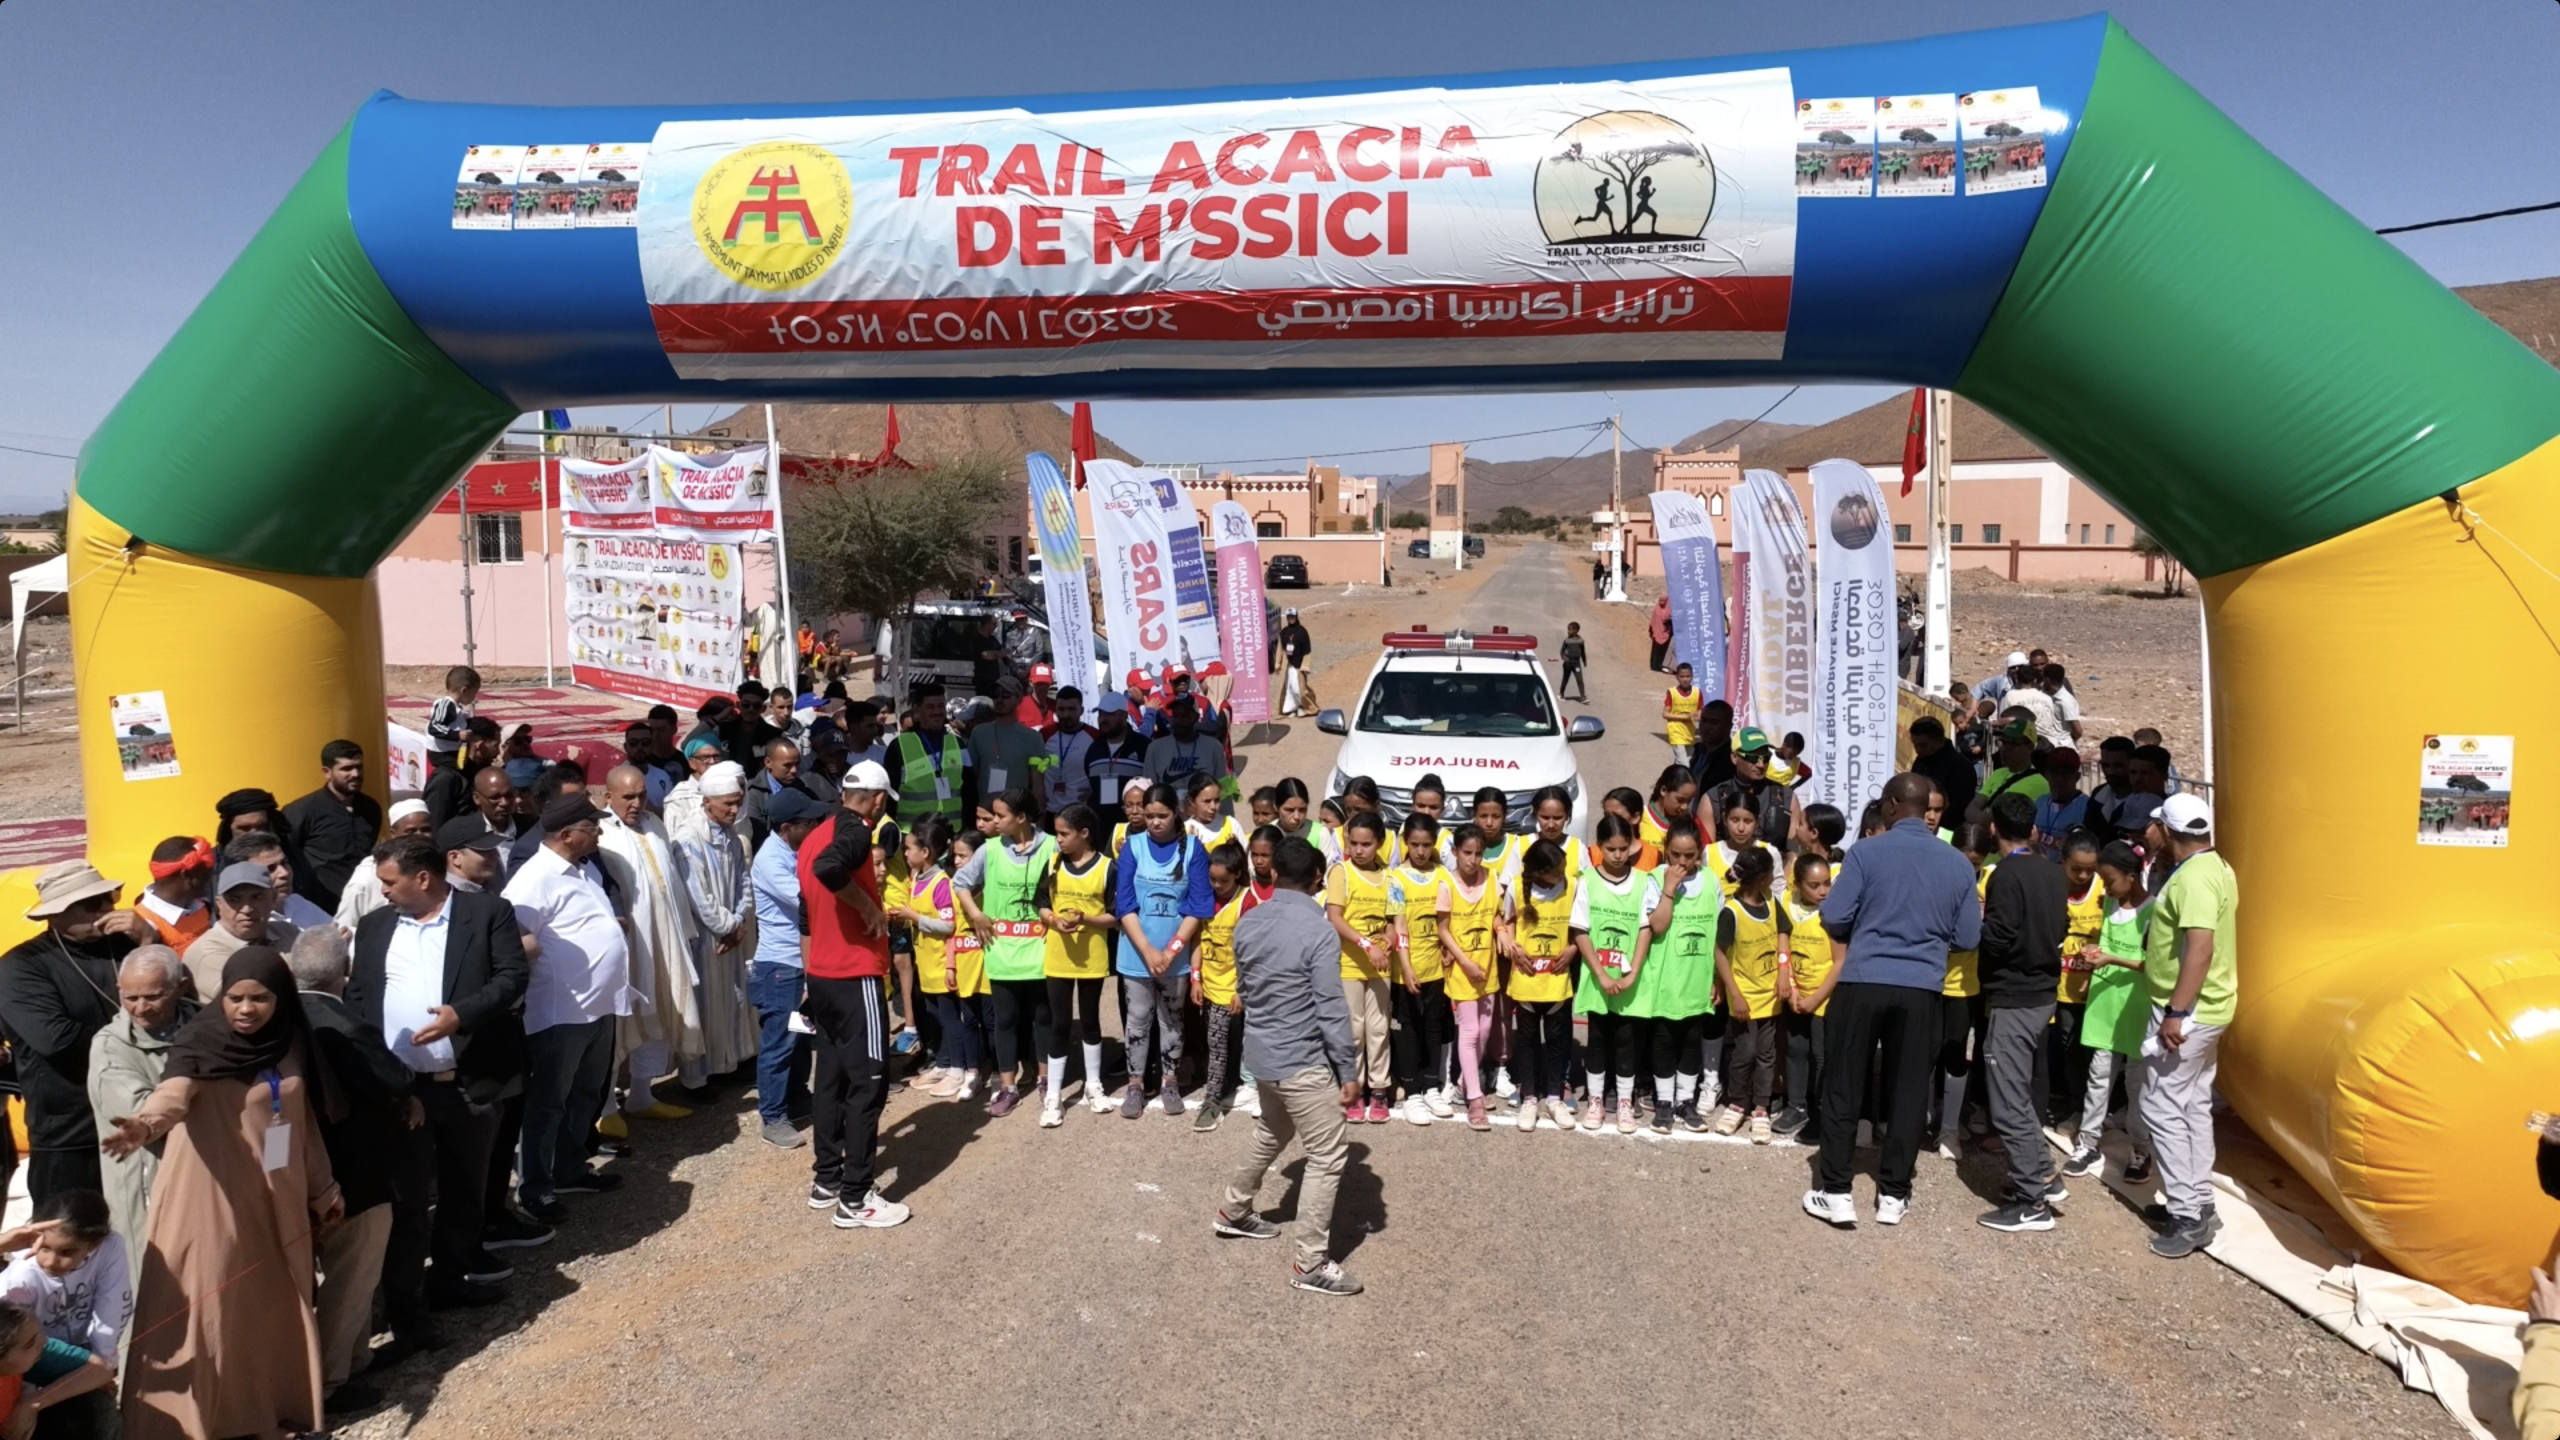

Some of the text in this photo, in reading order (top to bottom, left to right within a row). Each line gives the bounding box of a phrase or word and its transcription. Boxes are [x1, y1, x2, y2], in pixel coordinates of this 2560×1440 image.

[889, 142, 1126, 198] TRAIL
[1149, 125, 1492, 193] ACACIA
[956, 191, 1409, 268] DE M'SSICI
[702, 226, 743, 274] TAMESMUNT
[744, 266, 781, 284] TAYMAT
[788, 259, 818, 280] YIDLES
[816, 254, 825, 267] D
[1545, 243, 1705, 257] TRAIL ACACIA DE M'SSICI
[1257, 284, 1694, 338] ترايل أكاسيا امصيصي
[600, 471, 634, 488] ACACIA
[680, 466, 745, 483] TRAIL ACACIA
[683, 485, 697, 499] DE
[595, 540, 618, 557] TRAIL
[620, 540, 653, 558] ACACIA
[1169, 757, 1200, 772] NIKE
[940, 907, 954, 919] 68
[1533, 959, 1551, 971] 87
